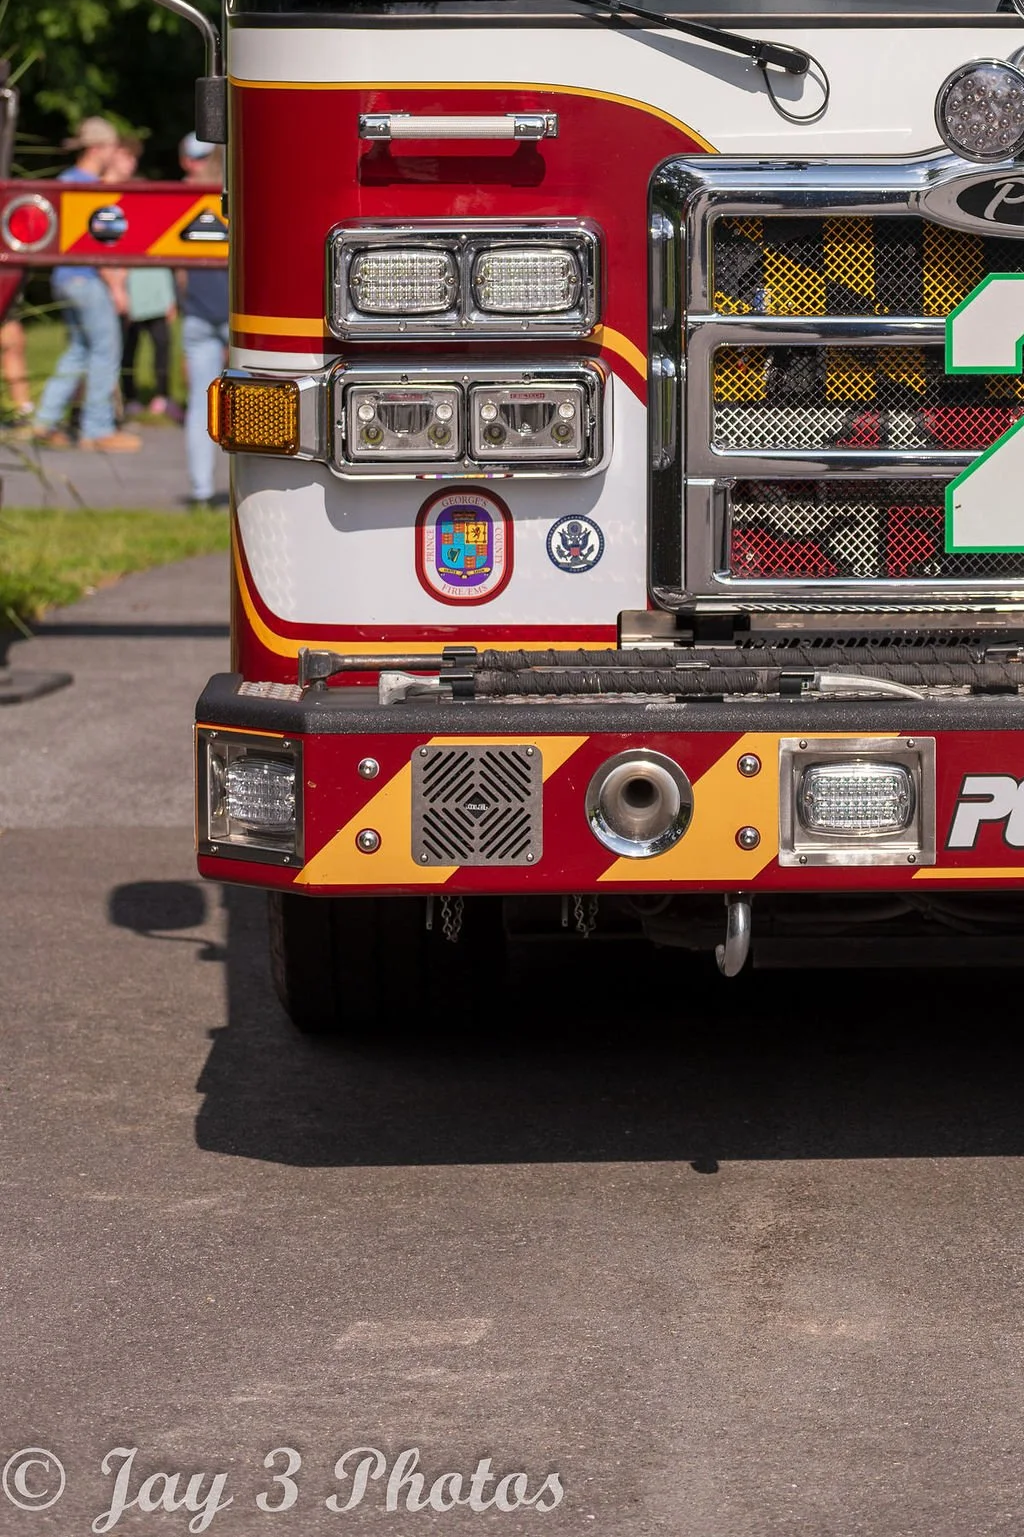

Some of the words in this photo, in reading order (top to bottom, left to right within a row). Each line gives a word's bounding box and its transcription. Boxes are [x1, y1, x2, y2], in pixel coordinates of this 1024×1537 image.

[441, 495, 488, 508] GEORGE'S
[426, 528, 435, 563] PRINCE
[494, 527, 504, 564] COUNTY
[441, 583, 488, 596] FIRE/EMS
